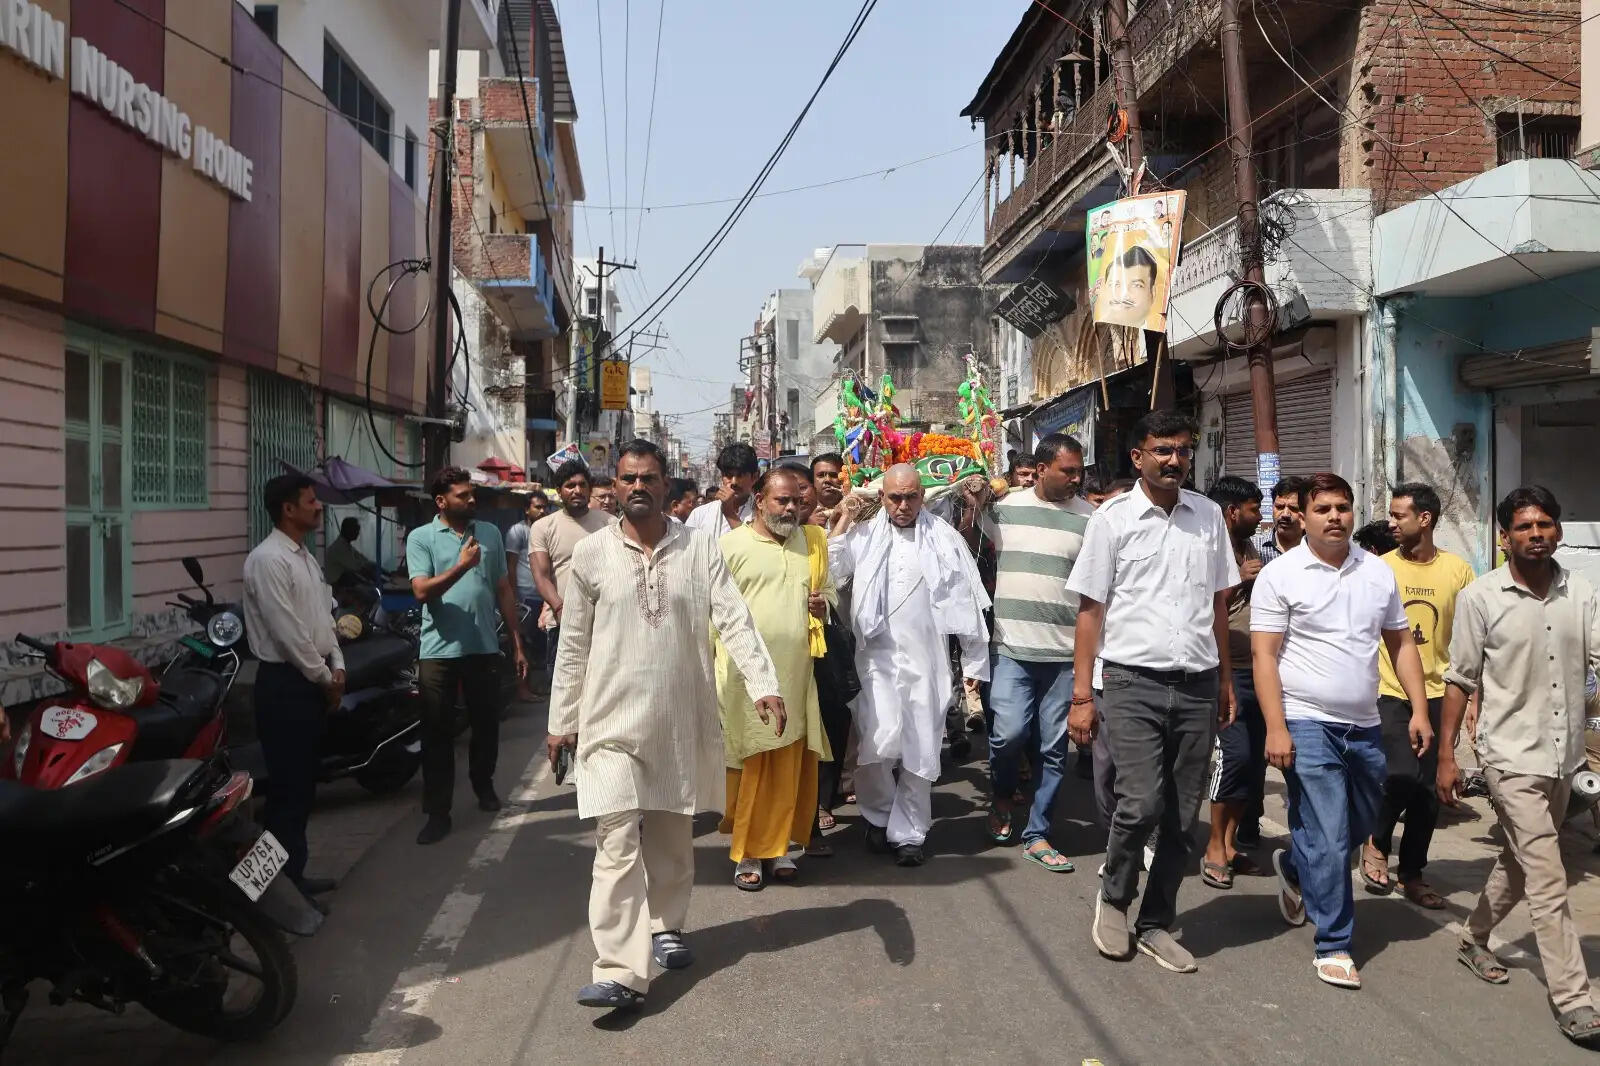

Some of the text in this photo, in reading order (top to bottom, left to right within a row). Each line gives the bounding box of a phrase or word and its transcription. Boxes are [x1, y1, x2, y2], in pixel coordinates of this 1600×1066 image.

[0, 0, 253, 202] RIN NURSING HOME
[1405, 586, 1435, 597] KARMA
[238, 839, 273, 879] UP76A
[250, 850, 285, 892] M4674
